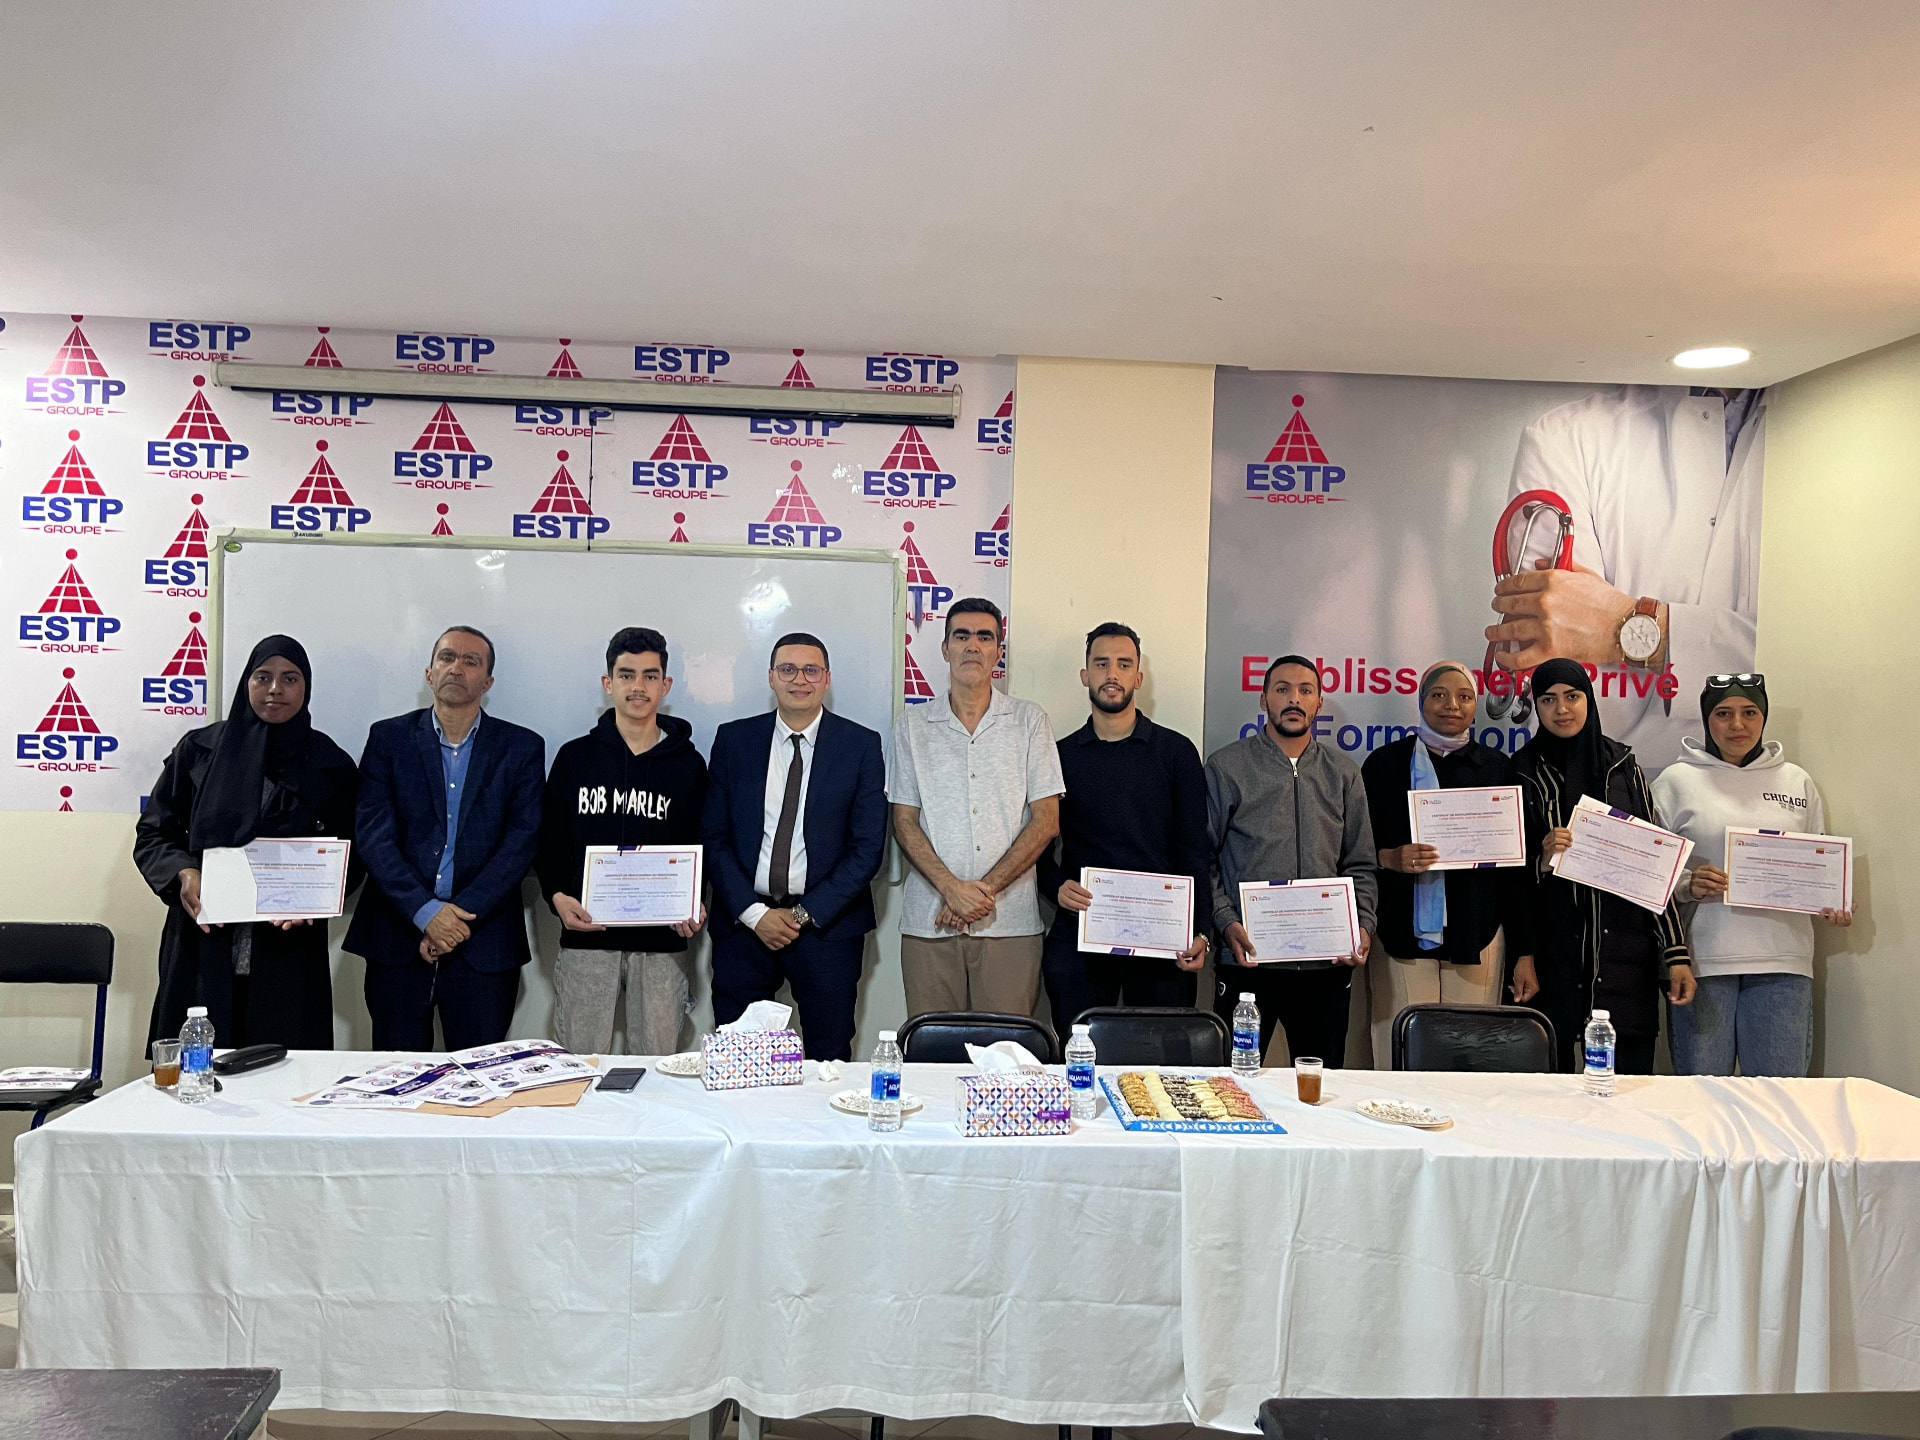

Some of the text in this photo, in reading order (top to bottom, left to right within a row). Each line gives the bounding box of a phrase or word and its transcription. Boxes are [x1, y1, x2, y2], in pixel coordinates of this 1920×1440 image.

[149, 322, 251, 350] ESTP
[171, 351, 229, 362] GROUPE
[396, 334, 495, 363] ESTP
[417, 363, 474, 374] GROUPE
[634, 346, 730, 374] ESTP
[655, 374, 709, 383] GROUPE
[866, 357, 959, 385] ESTP
[26, 377, 126, 404] ESTP
[885, 385, 939, 393] GROUPE
[47, 405, 104, 416] GROUPE
[273, 391, 374, 416] ESTP
[294, 416, 352, 427] GROUPE
[515, 405, 612, 426] ESTP
[536, 427, 592, 437] GROUPE
[750, 417, 845, 437] ESTP
[770, 437, 824, 447] GROUPE
[147, 441, 249, 469] ESTP
[169, 470, 227, 481] GROUPE
[394, 451, 493, 480] ESTP
[632, 461, 728, 489] ESTP
[415, 480, 472, 491] GROUPE
[863, 471, 957, 498] ESTP
[1247, 464, 1346, 492] ESTP
[653, 489, 708, 500] GROUPE
[883, 498, 937, 509] GROUPE
[1267, 494, 1325, 504] GROUPE
[22, 496, 123, 523] ESTP
[271, 505, 371, 532] ESTP
[44, 525, 101, 535] GROUPE
[513, 514, 610, 540] ESTP
[748, 523, 842, 548] ESTP
[167, 588, 208, 597] GROU
[908, 586, 953, 610] TP
[20, 616, 121, 642] ESTP
[41, 644, 98, 654] GROUPE
[164, 706, 207, 715] GROU
[17, 734, 118, 761] ESTP
[38, 762, 96, 773] GROUPE
[579, 786, 671, 820] BOB MARLEY
[1763, 793, 1807, 808] CHICAGO
